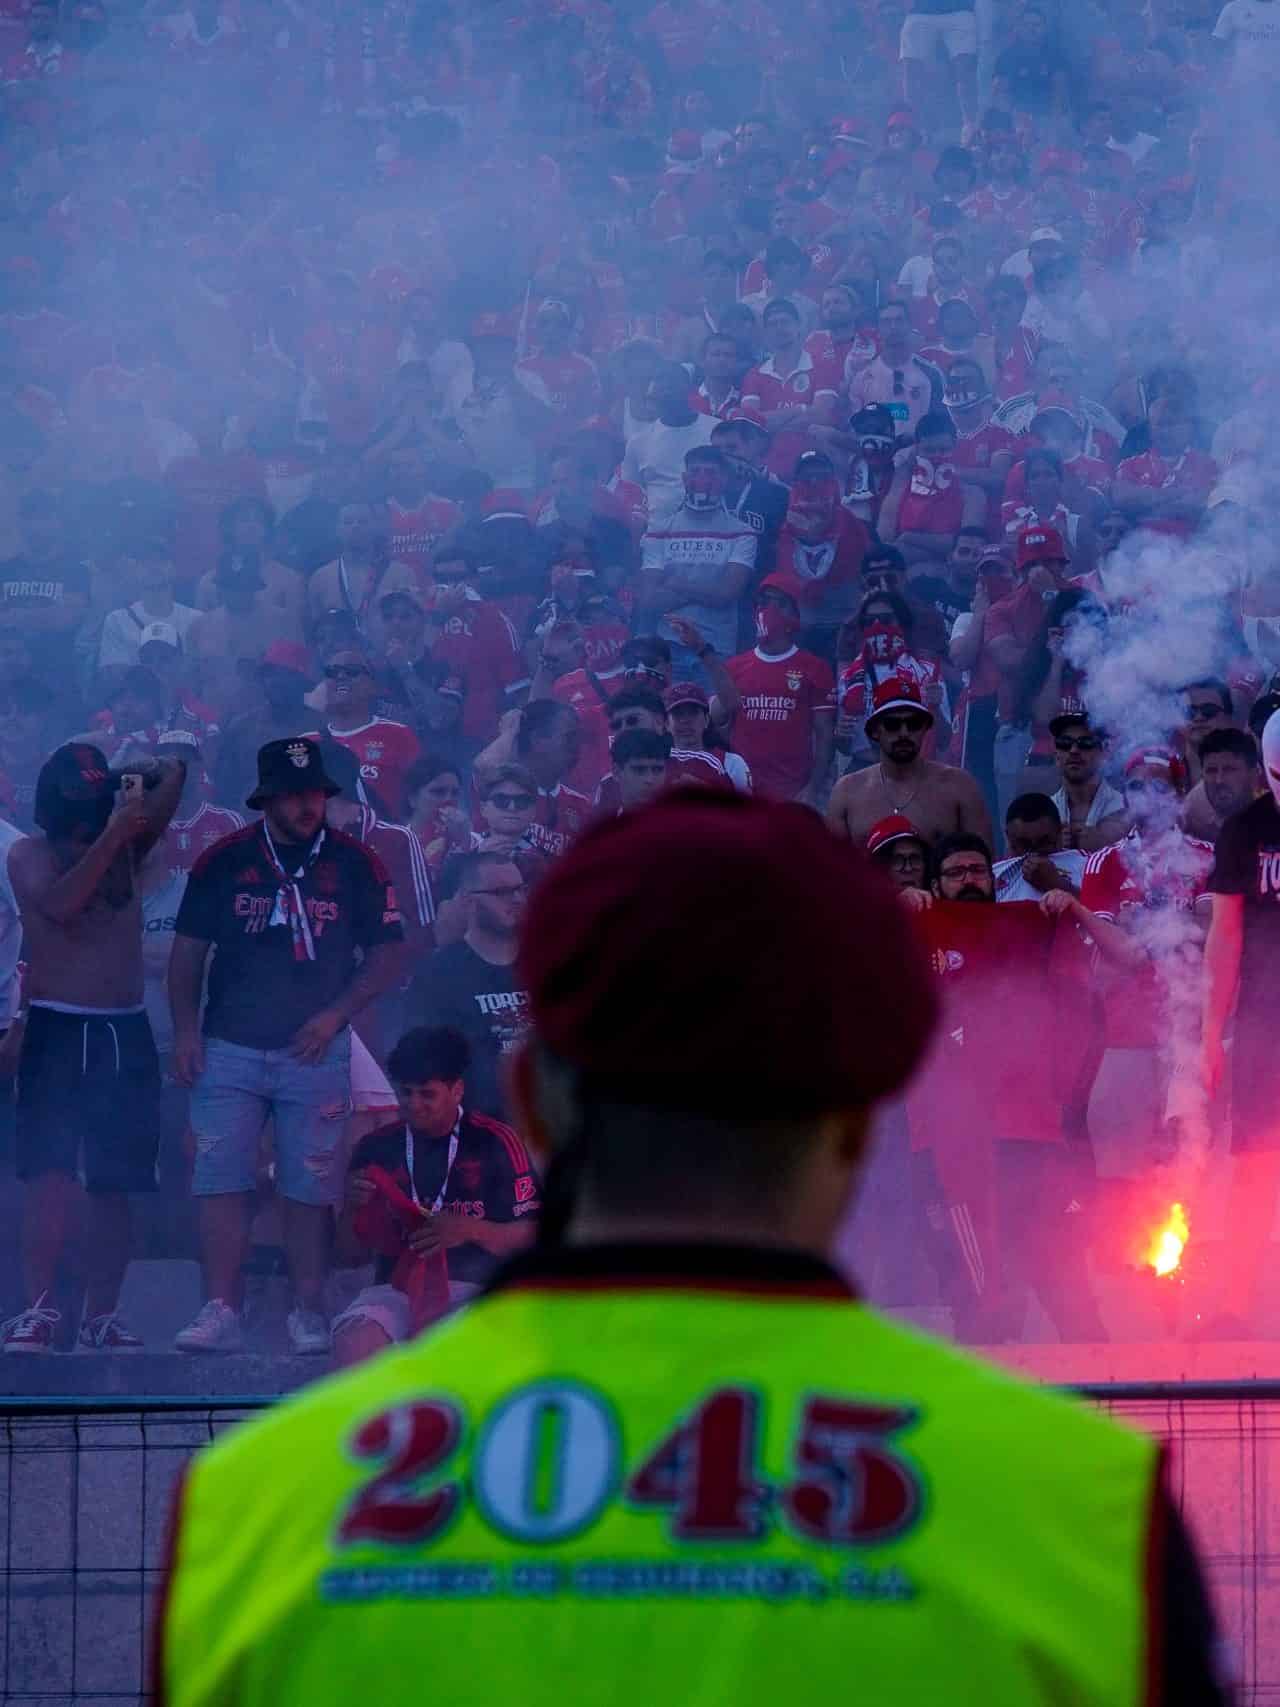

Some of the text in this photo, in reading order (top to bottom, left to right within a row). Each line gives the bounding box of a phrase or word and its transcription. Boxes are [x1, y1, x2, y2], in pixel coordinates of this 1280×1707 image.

[670, 541, 727, 553] GUESS
[740, 694, 797, 710] Emirates
[234, 893, 338, 920] Emtes
[475, 992, 530, 1014] TORC
[336, 1378, 925, 1550] 2045
